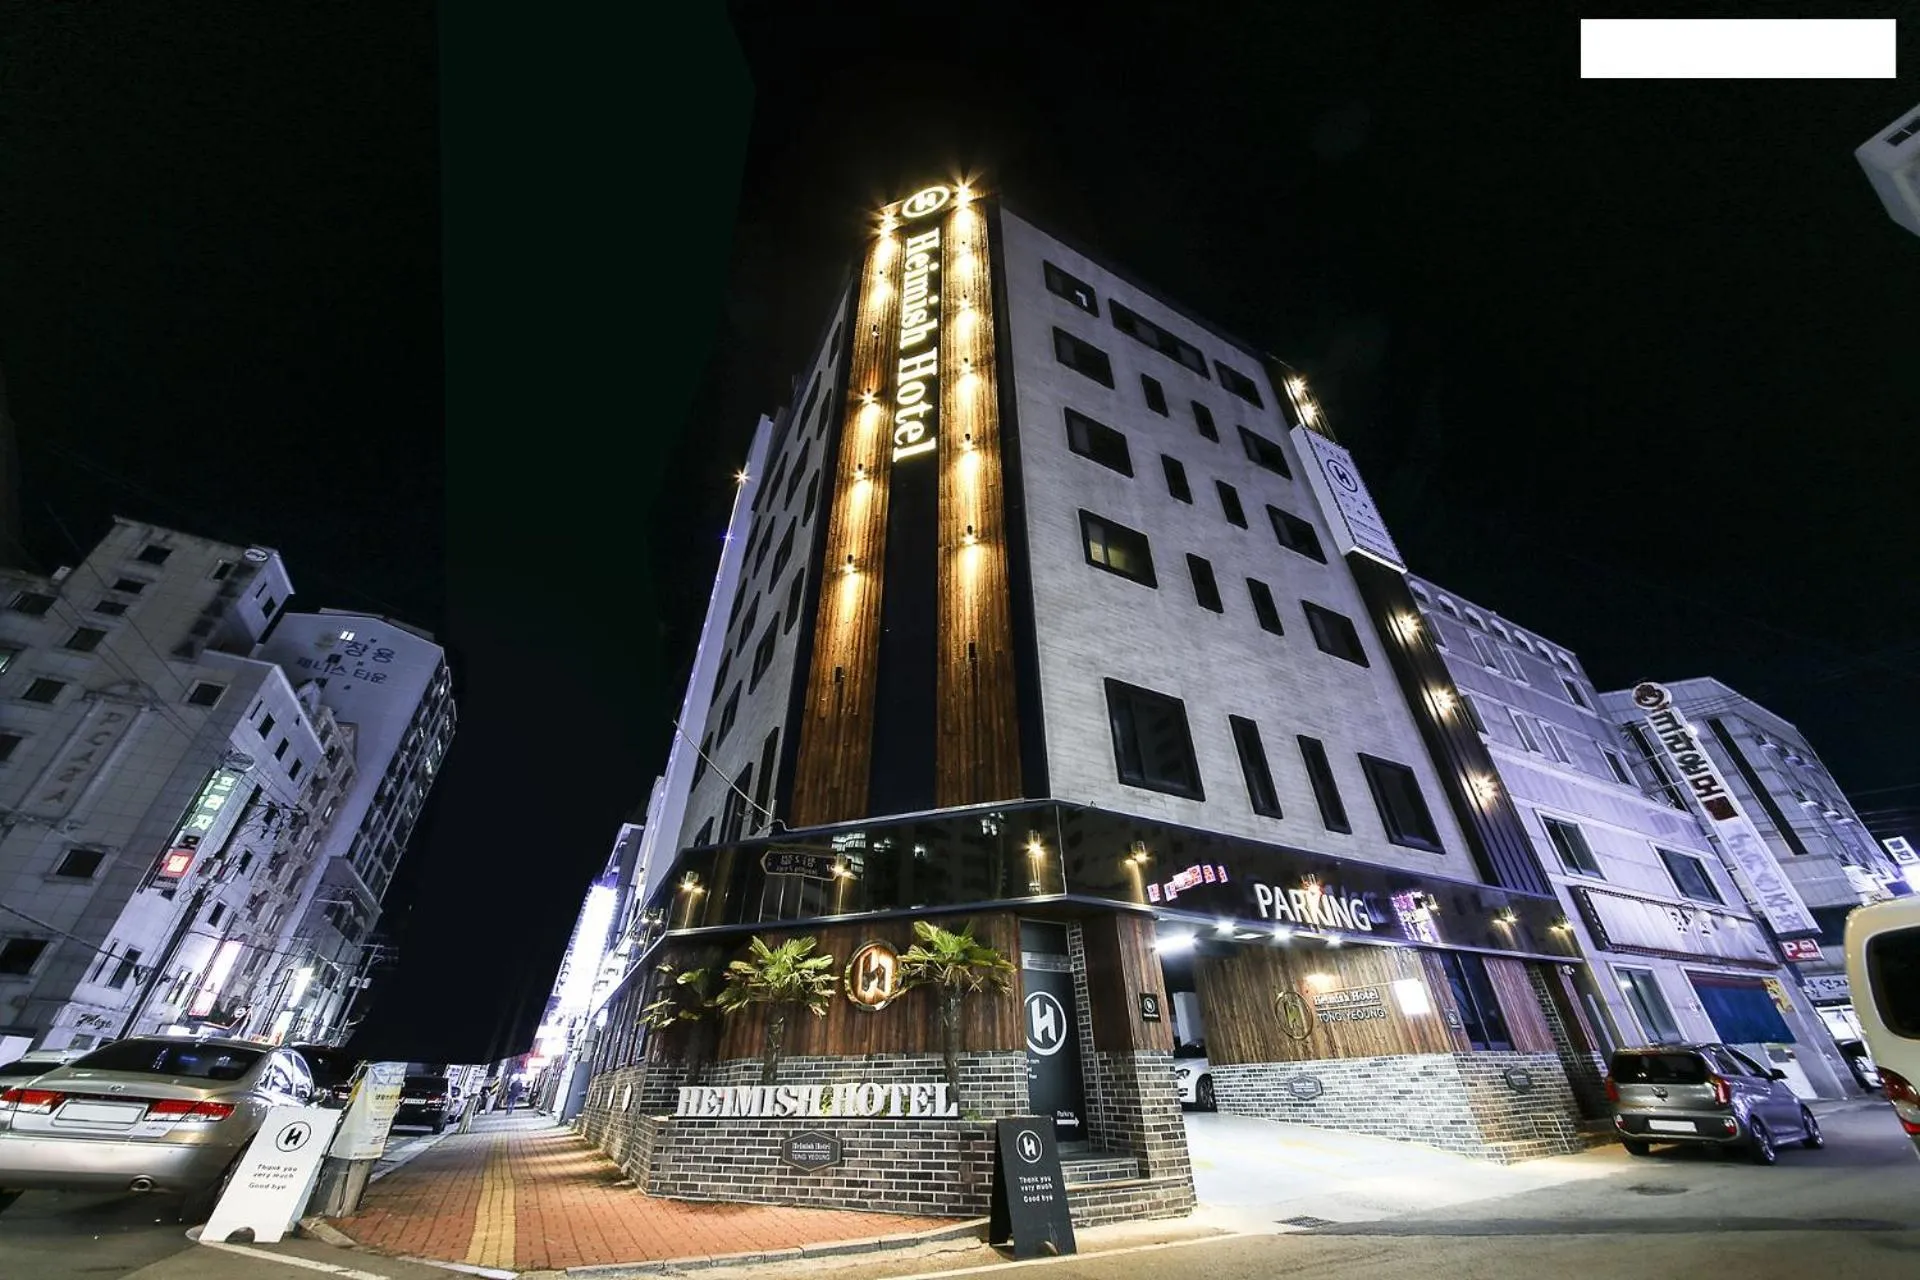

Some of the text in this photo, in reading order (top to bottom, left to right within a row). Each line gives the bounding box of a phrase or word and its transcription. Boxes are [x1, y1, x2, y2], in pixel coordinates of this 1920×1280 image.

[893, 227, 940, 463] Heimish Hotel
[1254, 883, 1373, 931] PARKING
[1783, 942, 1799, 957] P
[1313, 987, 1380, 1006] Heimish Hotel
[1318, 1007, 1387, 1023] TONG YEOUNG
[673, 1082, 959, 1117] HEIMISH HOTEL
